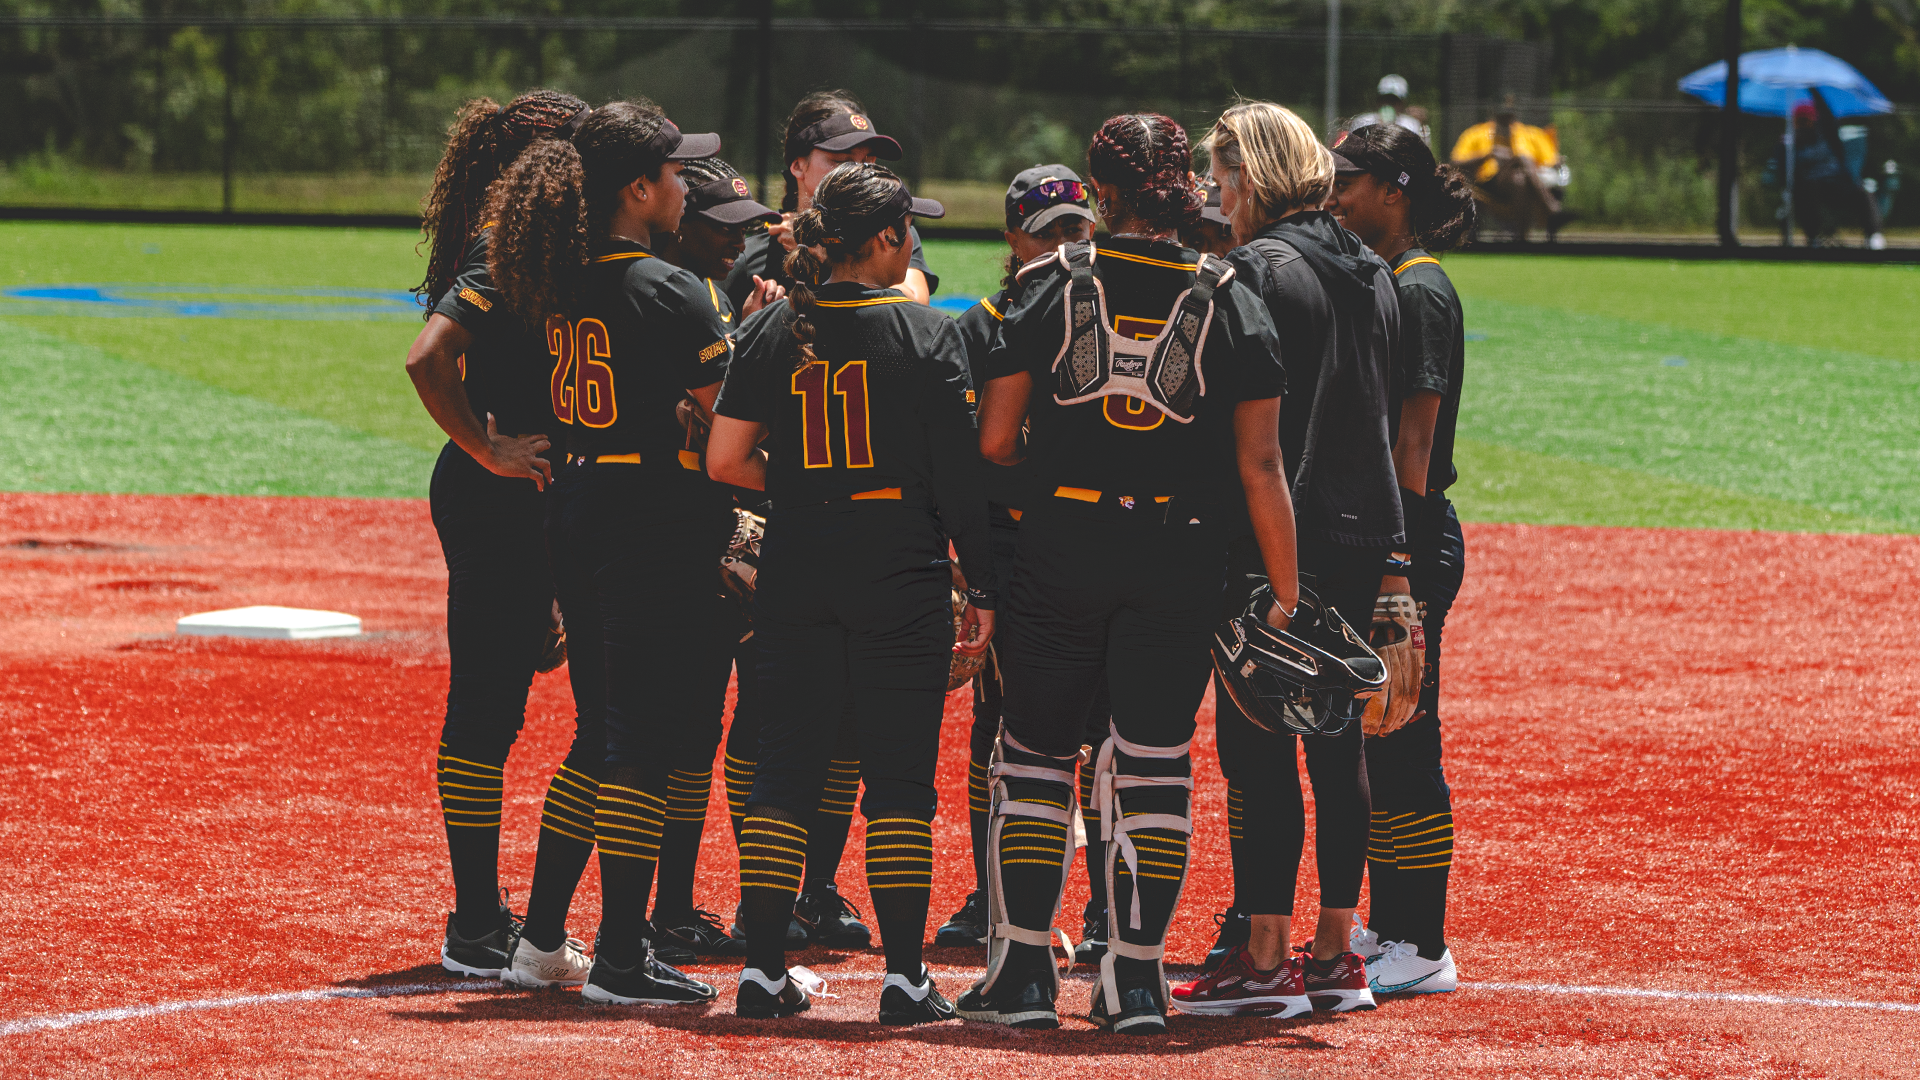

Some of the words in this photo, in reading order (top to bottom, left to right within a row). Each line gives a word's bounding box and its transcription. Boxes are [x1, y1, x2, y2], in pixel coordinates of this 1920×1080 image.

[458, 287, 493, 313] SWAC
[698, 339, 728, 364] SWAC
[546, 314, 617, 428] 26
[791, 360, 874, 469] 11
[539, 962, 569, 977] VAPOR
